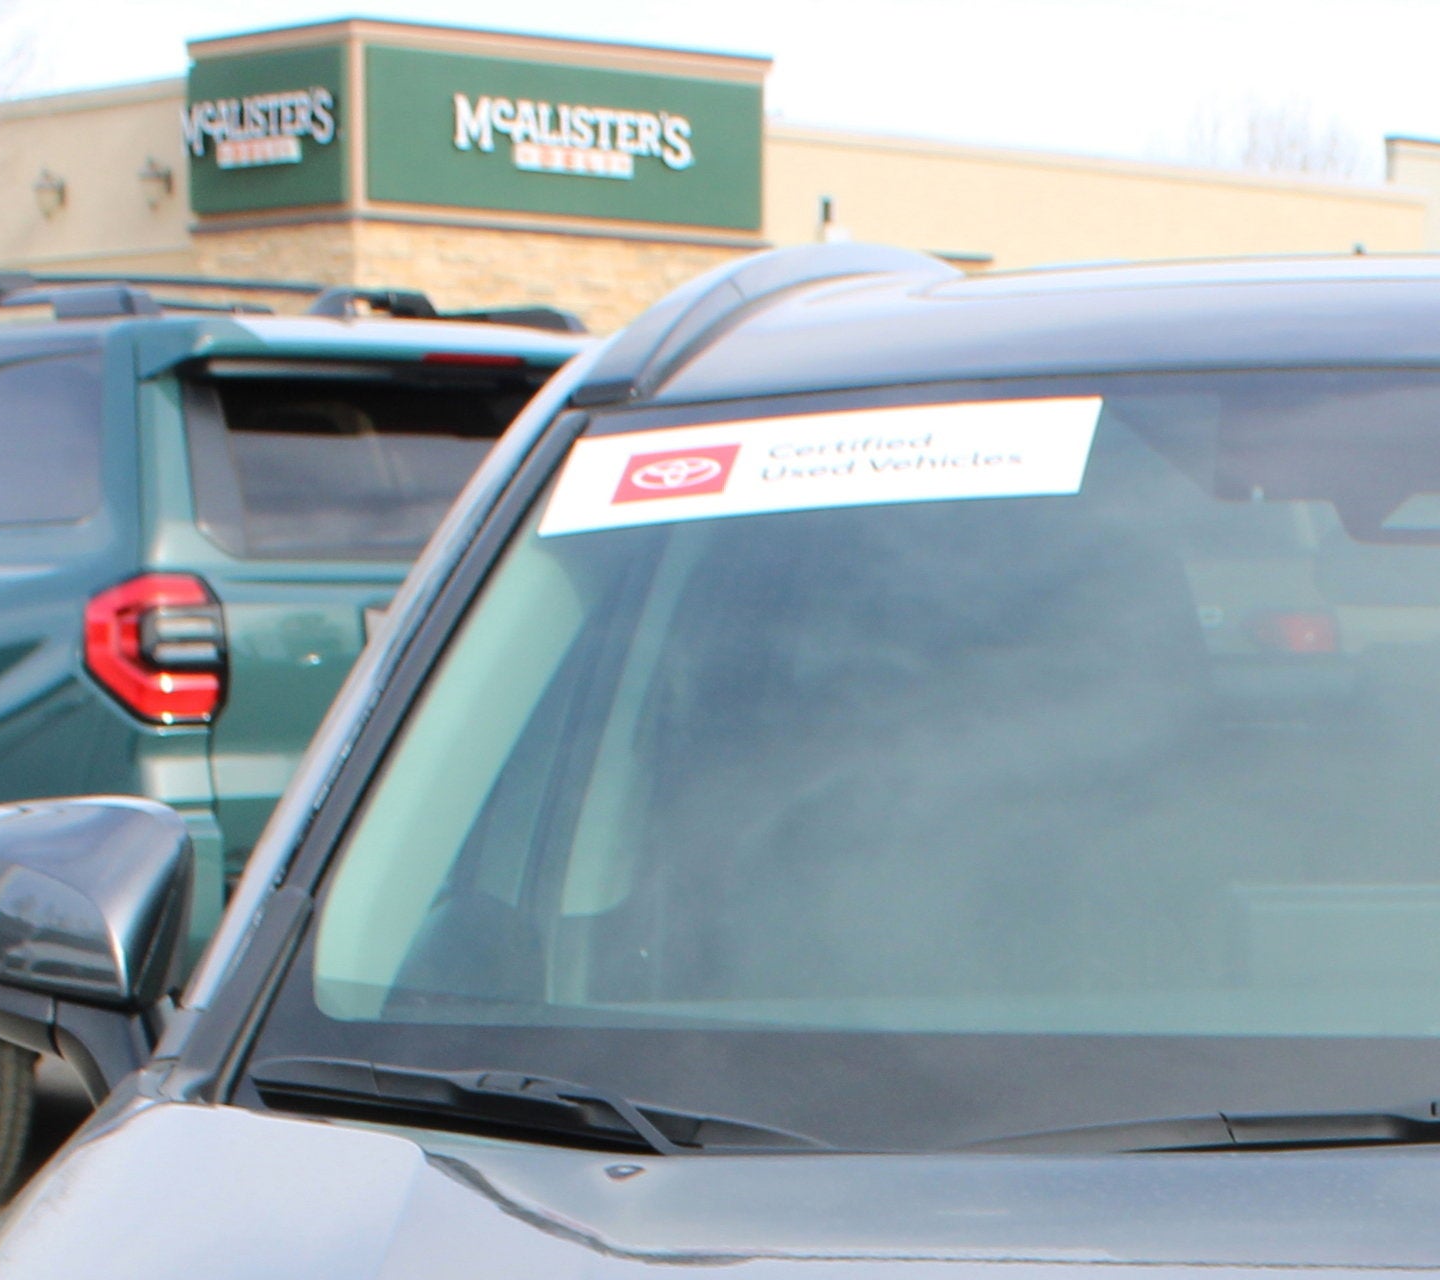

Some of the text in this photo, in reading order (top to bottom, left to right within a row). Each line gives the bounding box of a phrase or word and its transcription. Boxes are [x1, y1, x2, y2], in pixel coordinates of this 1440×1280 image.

[768, 432, 932, 459] Certified
[762, 452, 1022, 481] Used Vehicles
